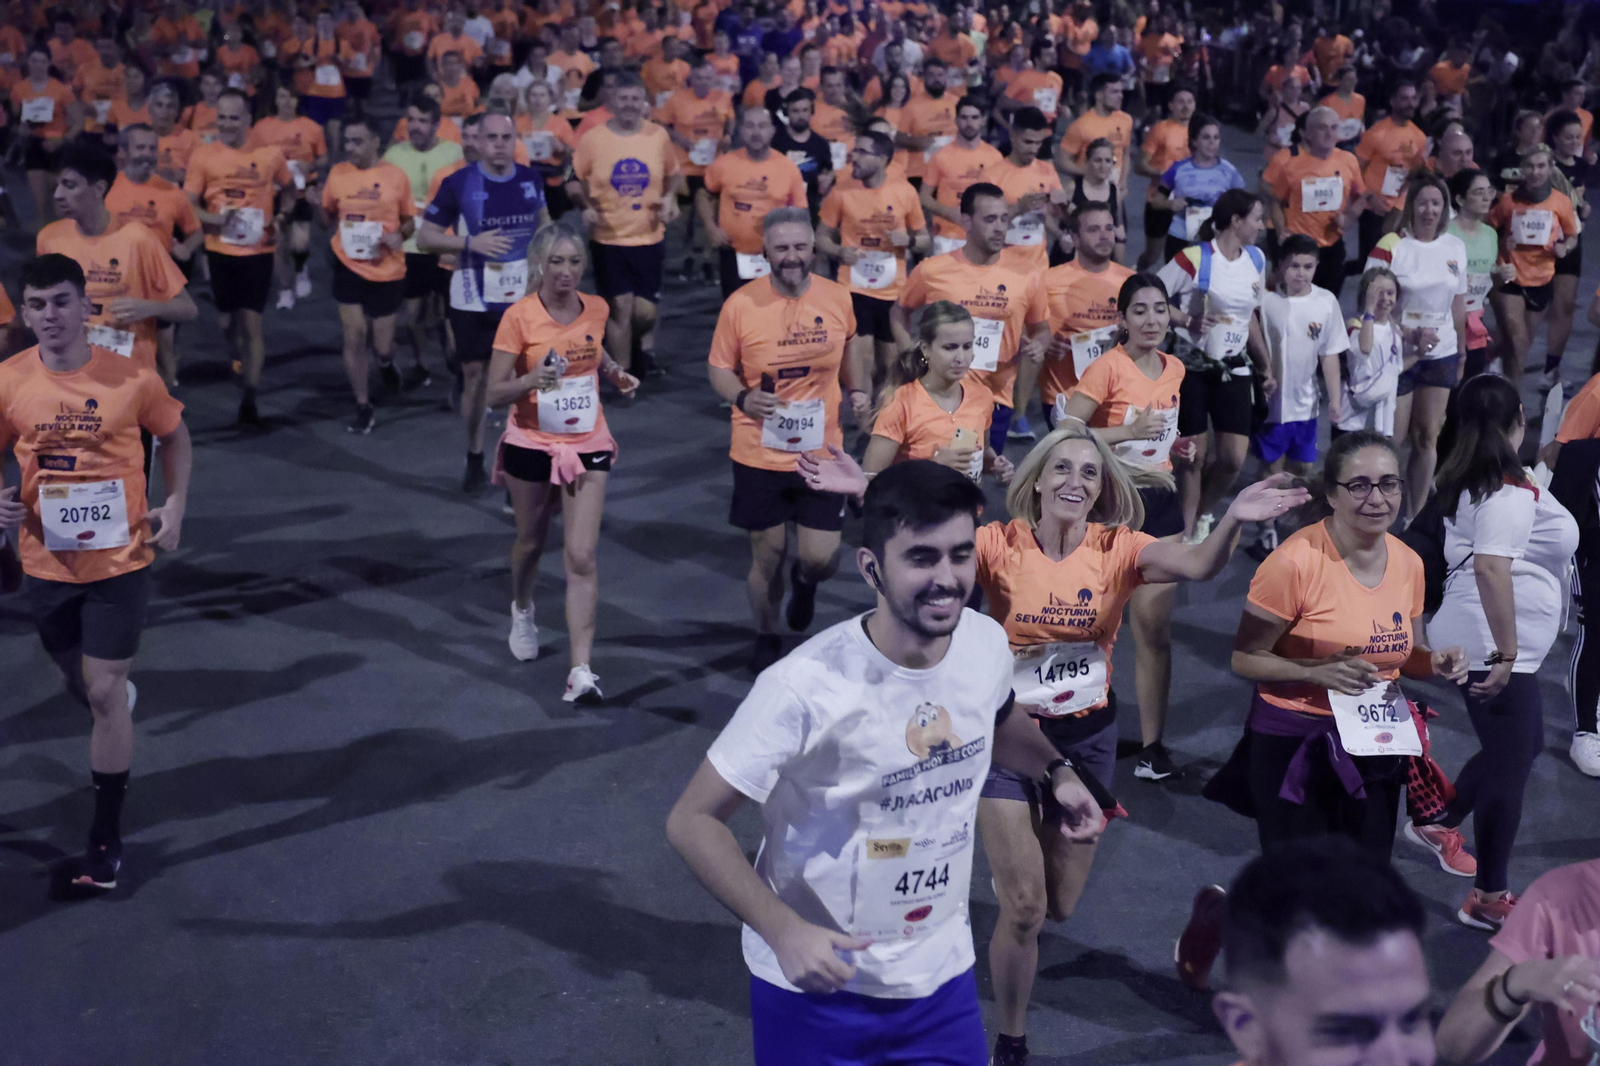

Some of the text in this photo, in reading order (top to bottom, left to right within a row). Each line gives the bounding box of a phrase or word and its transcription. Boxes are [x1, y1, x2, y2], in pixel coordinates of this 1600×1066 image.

[555, 395, 592, 412] 13623
[55, 414, 103, 423] NOCTURNA
[778, 416, 814, 431] 20194
[34, 422, 102, 433] SEVILLA KH7
[60, 504, 111, 523] 20782
[1041, 606, 1098, 617] NOCTURNA
[1015, 612, 1097, 629] SEVILLA KH7
[1369, 631, 1409, 644] NOCTURNA
[1391, 640, 1409, 653] KH7
[1034, 657, 1090, 685] 14795
[1357, 703, 1399, 723] 9672
[894, 862, 949, 896] 4744
